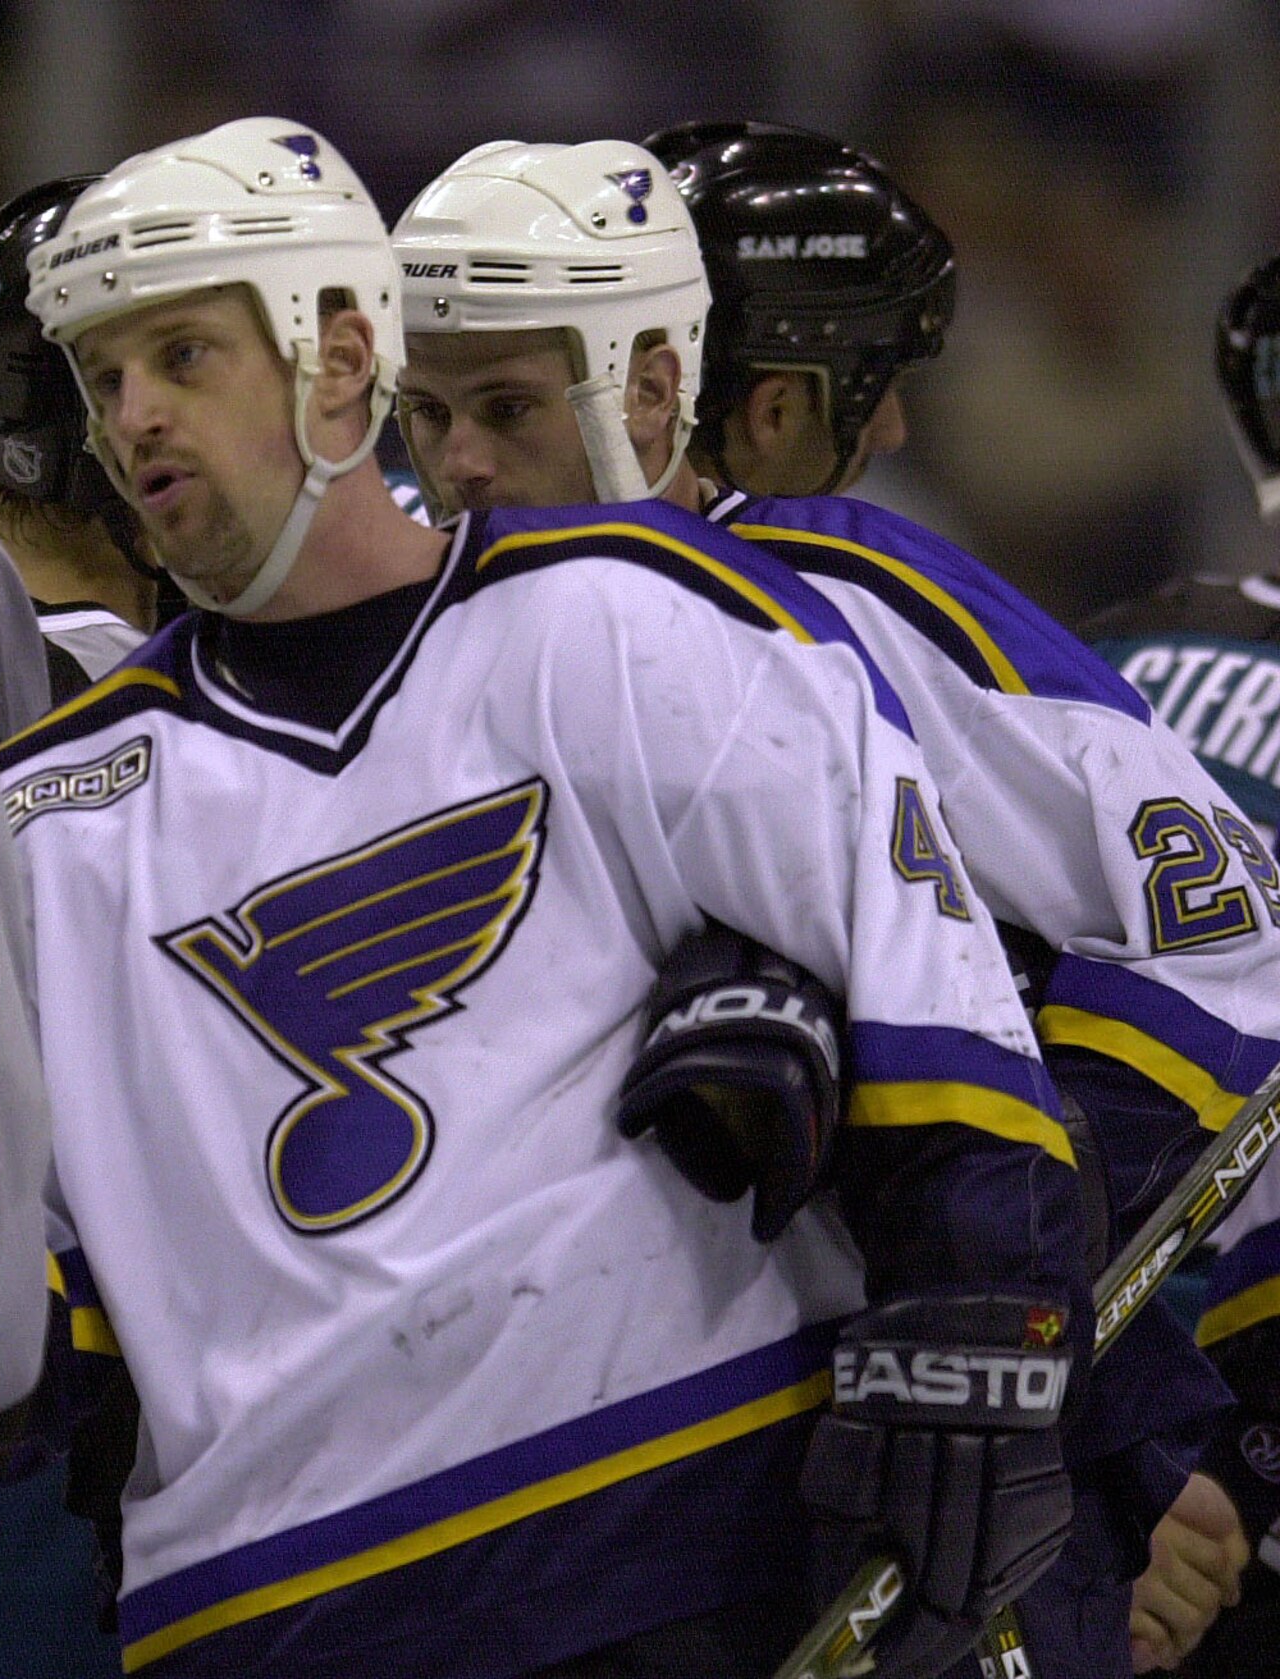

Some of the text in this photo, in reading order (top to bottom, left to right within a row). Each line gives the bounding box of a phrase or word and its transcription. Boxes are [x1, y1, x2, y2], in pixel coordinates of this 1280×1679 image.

[49, 234, 120, 269] BAUER
[738, 234, 866, 259] SAN JOSE
[891, 775, 974, 923] 4
